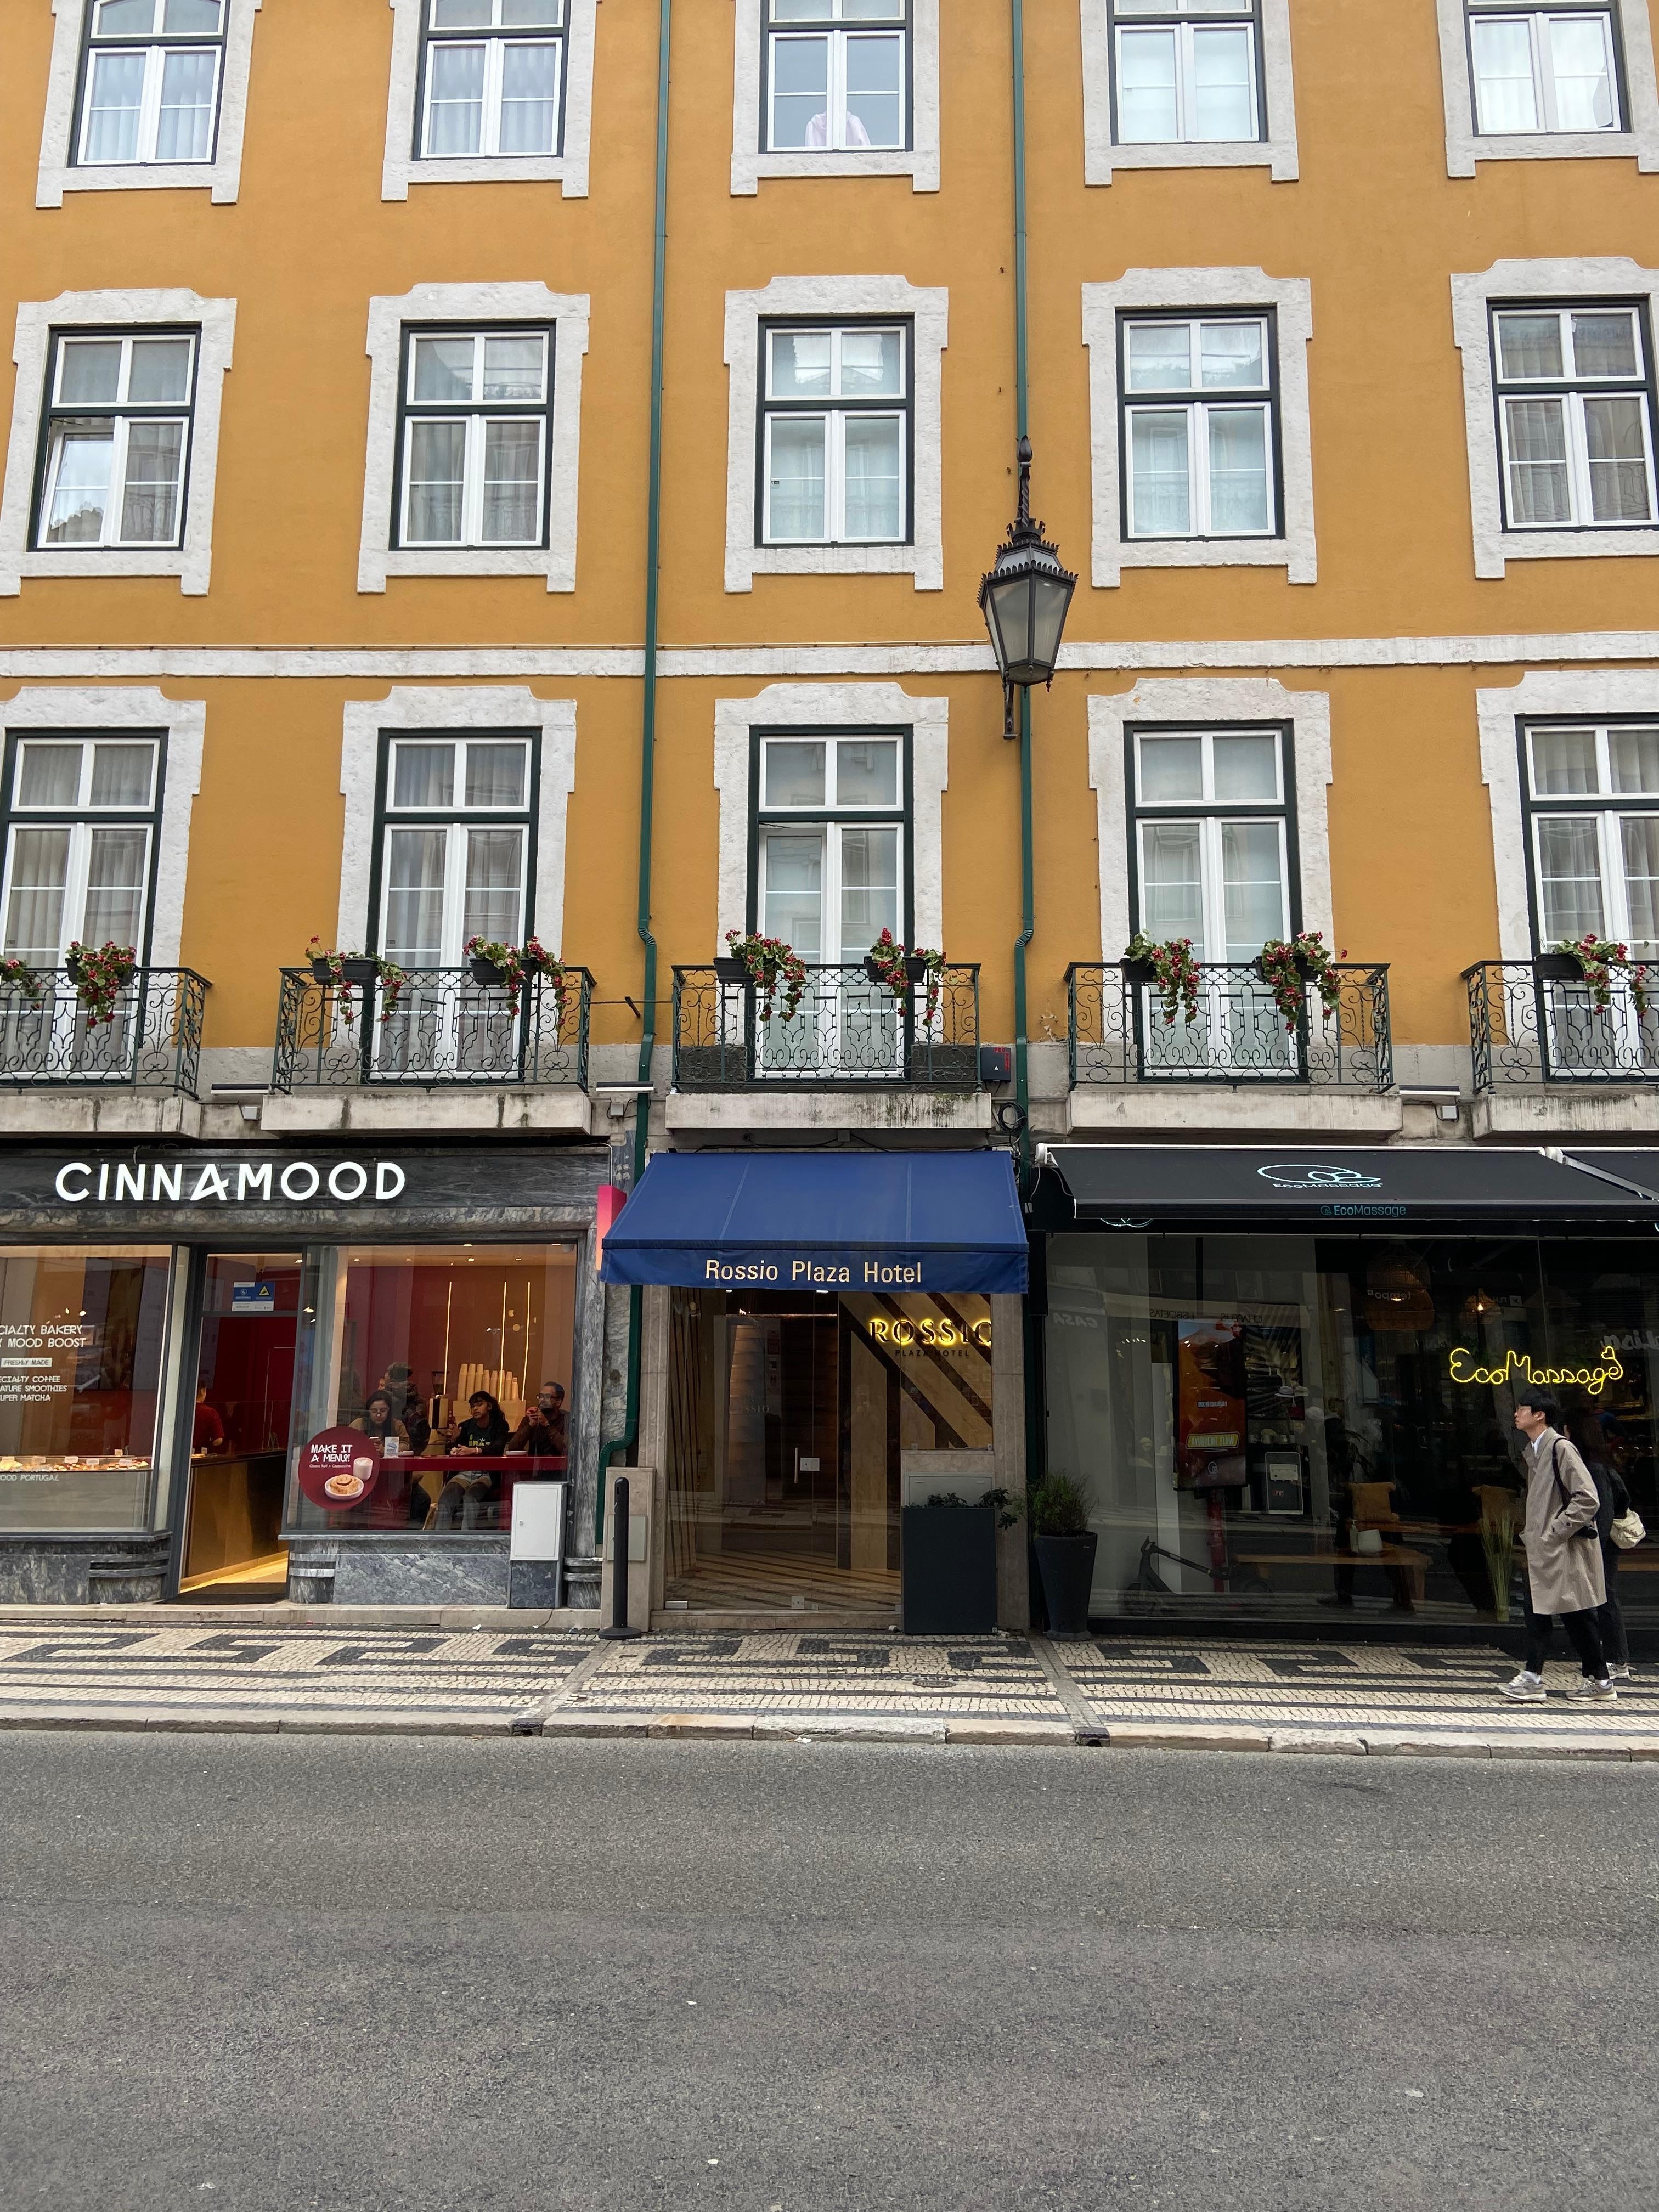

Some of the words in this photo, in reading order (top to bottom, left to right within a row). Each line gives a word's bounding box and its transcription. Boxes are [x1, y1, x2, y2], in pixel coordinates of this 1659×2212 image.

[55, 1161, 405, 1201] CINNAMOOD
[1334, 1205, 1406, 1217] EcoMassage
[705, 1259, 778, 1281] Rossio
[792, 1260, 850, 1283] Plaza
[864, 1261, 922, 1284] Hotel
[40, 1325, 83, 1335] BAKERY
[8, 1338, 43, 1348] MOOD
[48, 1338, 87, 1348] BOOST
[1450, 1346, 1623, 1395] EcoMassage
[311, 1444, 337, 1453] MAKE
[340, 1444, 353, 1453] IT
[311, 1454, 319, 1463] A
[323, 1454, 351, 1463] MENU!
